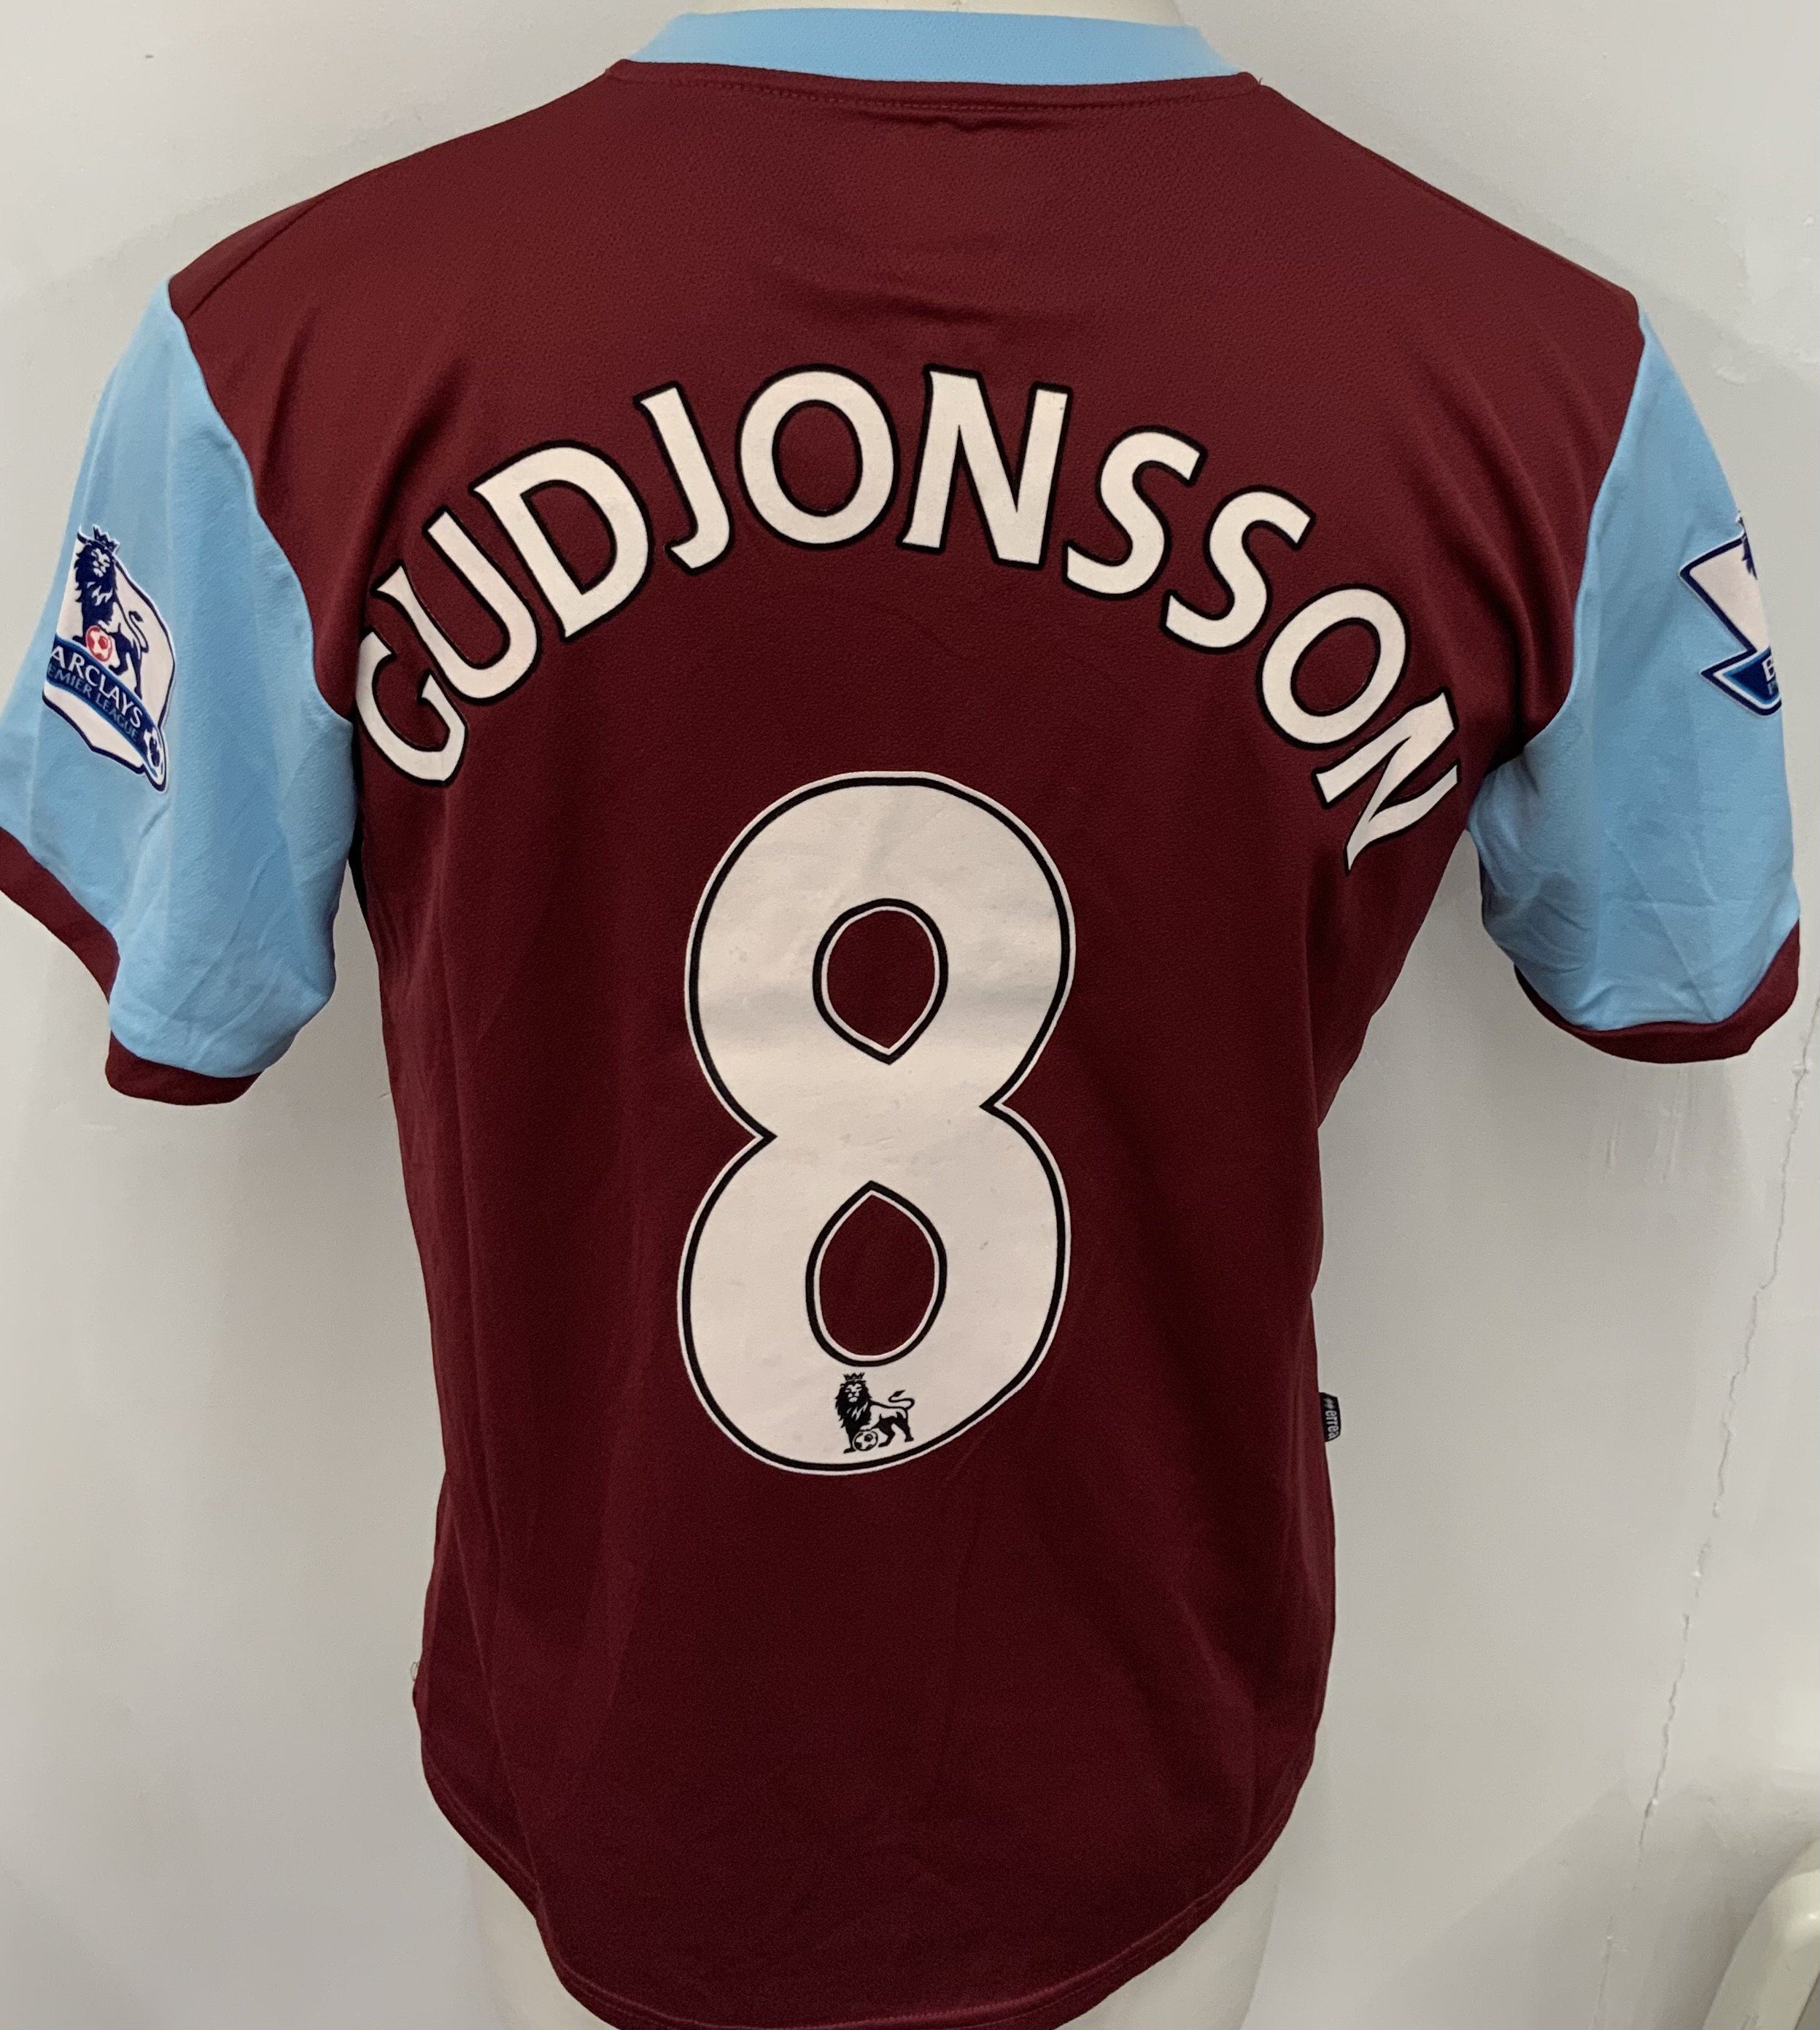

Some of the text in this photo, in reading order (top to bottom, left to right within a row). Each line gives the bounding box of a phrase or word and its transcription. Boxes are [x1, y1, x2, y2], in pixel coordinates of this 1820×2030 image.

[47, 663, 139, 742] EMIER LEAGUE
[50, 646, 143, 728] ARCLAYS
[355, 364, 1460, 872] GUDJONSSON
[677, 770, 1076, 1476] 8
